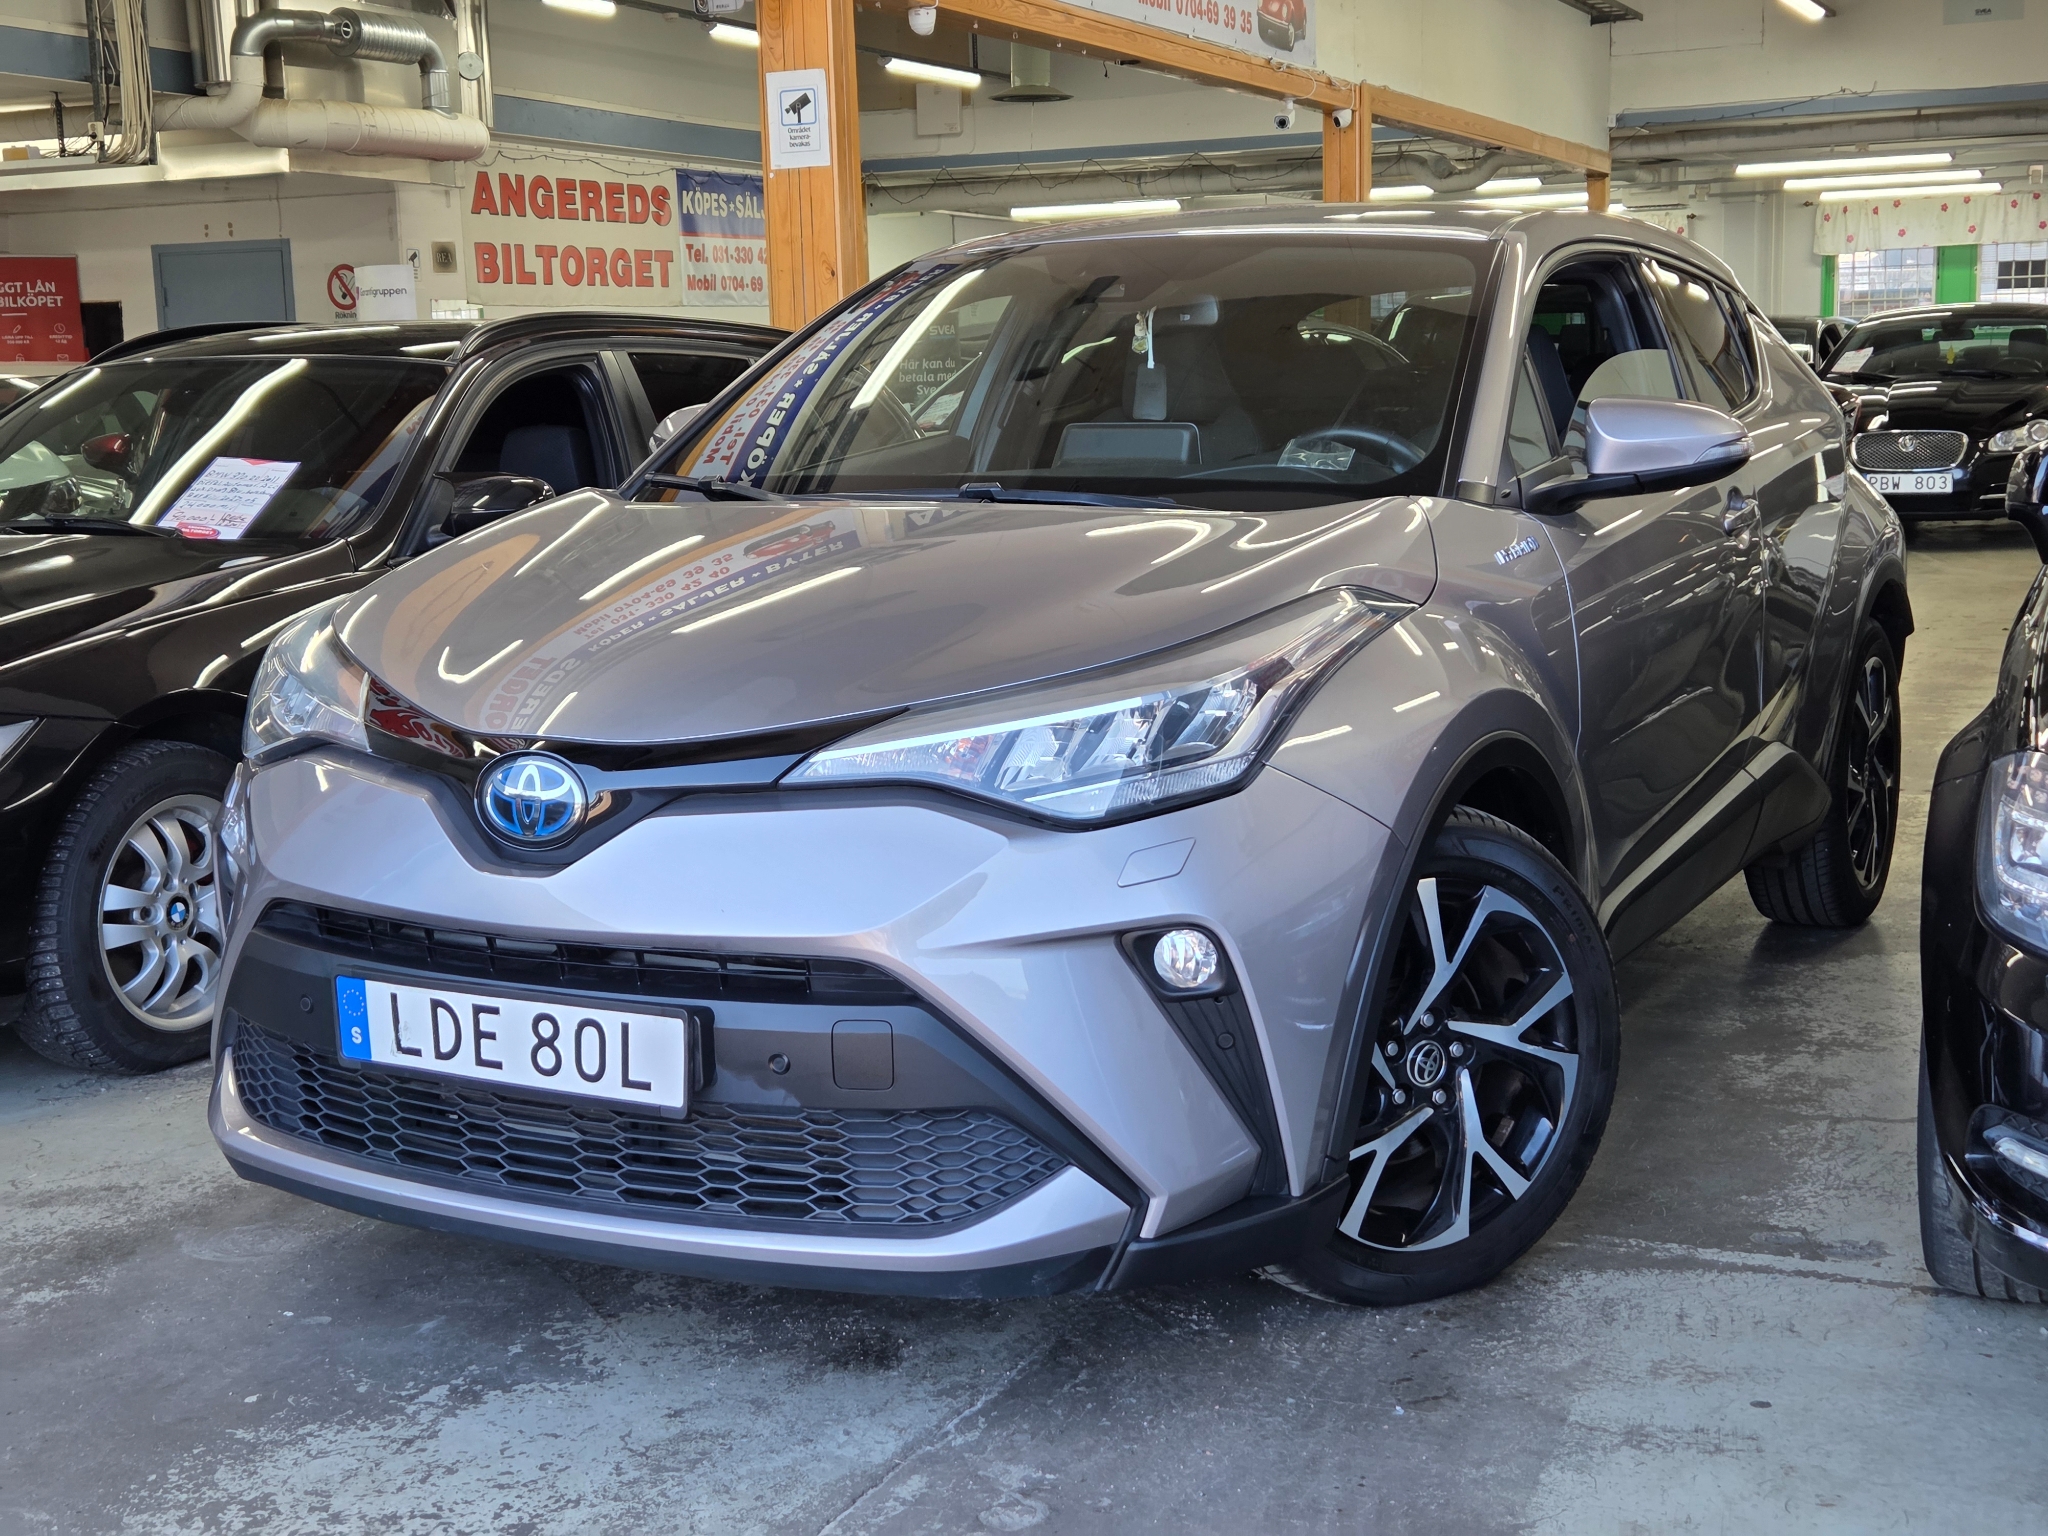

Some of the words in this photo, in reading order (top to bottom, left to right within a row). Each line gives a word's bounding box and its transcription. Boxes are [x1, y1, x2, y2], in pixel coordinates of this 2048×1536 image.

[1137, 0, 1171, 11] obil
[1175, 0, 1219, 25] 0704-69
[1223, 4, 1236, 30] 39
[1240, 9, 1252, 34] 35
[787, 126, 811, 134] Området
[471, 171, 672, 226] ANGEREDS
[682, 187, 728, 217] KÖPES
[686, 244, 708, 263] Tel.
[712, 245, 753, 265] 031-330
[474, 242, 673, 287] BILTORGET
[26, 279, 56, 293] LÅN
[687, 275, 716, 291] Mobil
[720, 275, 764, 292] 0704-69
[335, 311, 357, 319] Röknin
[929, 325, 955, 335] SVEA
[900, 360, 919, 370] Här
[922, 359, 943, 369] kan
[945, 358, 956, 367] du
[899, 372, 935, 382] betala
[916, 385, 941, 395] Sve
[1869, 477, 1901, 490] PBW
[1915, 476, 1947, 490] 803
[351, 1026, 362, 1044] S
[390, 992, 503, 1070] LDE
[530, 1012, 652, 1092] 80L
